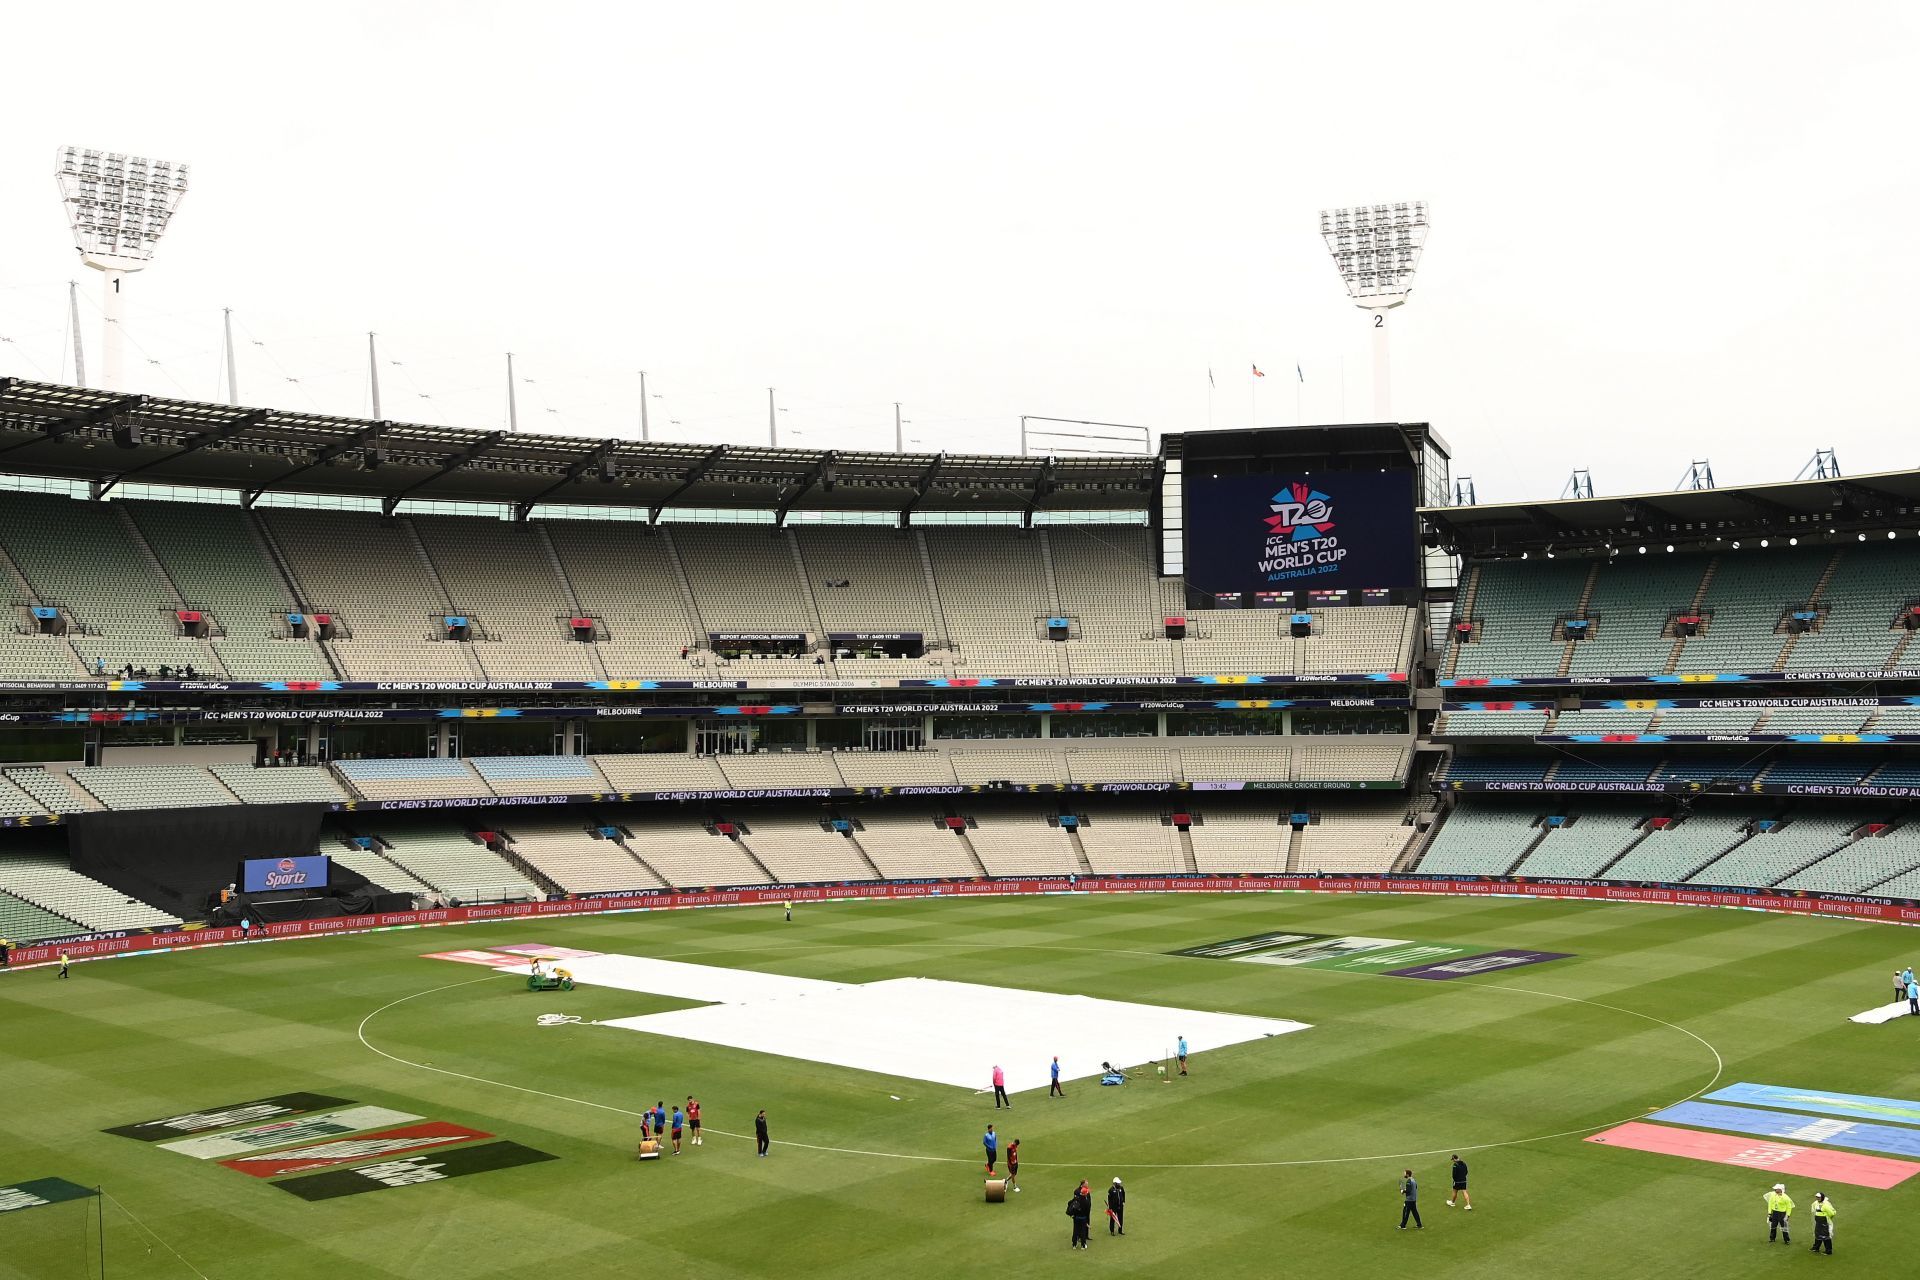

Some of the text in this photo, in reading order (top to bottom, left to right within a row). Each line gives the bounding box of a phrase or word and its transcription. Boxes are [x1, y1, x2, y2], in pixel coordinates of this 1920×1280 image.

[113, 278, 119, 293] 1
[1375, 314, 1383, 328] 2
[1265, 536, 1338, 558] MEN'S T20
[1266, 536, 1283, 545] ICC
[1258, 548, 1347, 572] WORLD CUP
[1268, 564, 1338, 581] AUSTRALIA 2022
[900, 786, 963, 794] #T20WORLDCUP
[1102, 783, 1170, 791] #T20WORLDCUP
[1853, 787, 1886, 795] WORLD
[1889, 788, 1907, 796] CUP
[655, 792, 670, 800] ICC
[671, 792, 696, 800] MEN'S
[714, 790, 745, 799] WORLD
[766, 789, 810, 798] AUSTRALIA
[381, 796, 567, 809] ICC MEN'S T20 WORLD CUP AUSTRALIA 2022
[266, 872, 306, 888] Sportz
[678, 895, 710, 903] Emirates
[1677, 893, 1710, 902] Emirates
[1723, 896, 1740, 904] BETTER
[539, 903, 572, 912] Emirates
[1818, 902, 1882, 915] Emirates FLY BETTER
[309, 920, 344, 930] Emirates
[356, 917, 376, 926] BETTER
[382, 911, 447, 923] Emirates FLY BETTER
[152, 931, 224, 946] Emirates FLY BETTER
[56, 940, 130, 956] Emirates FLY BETTER
